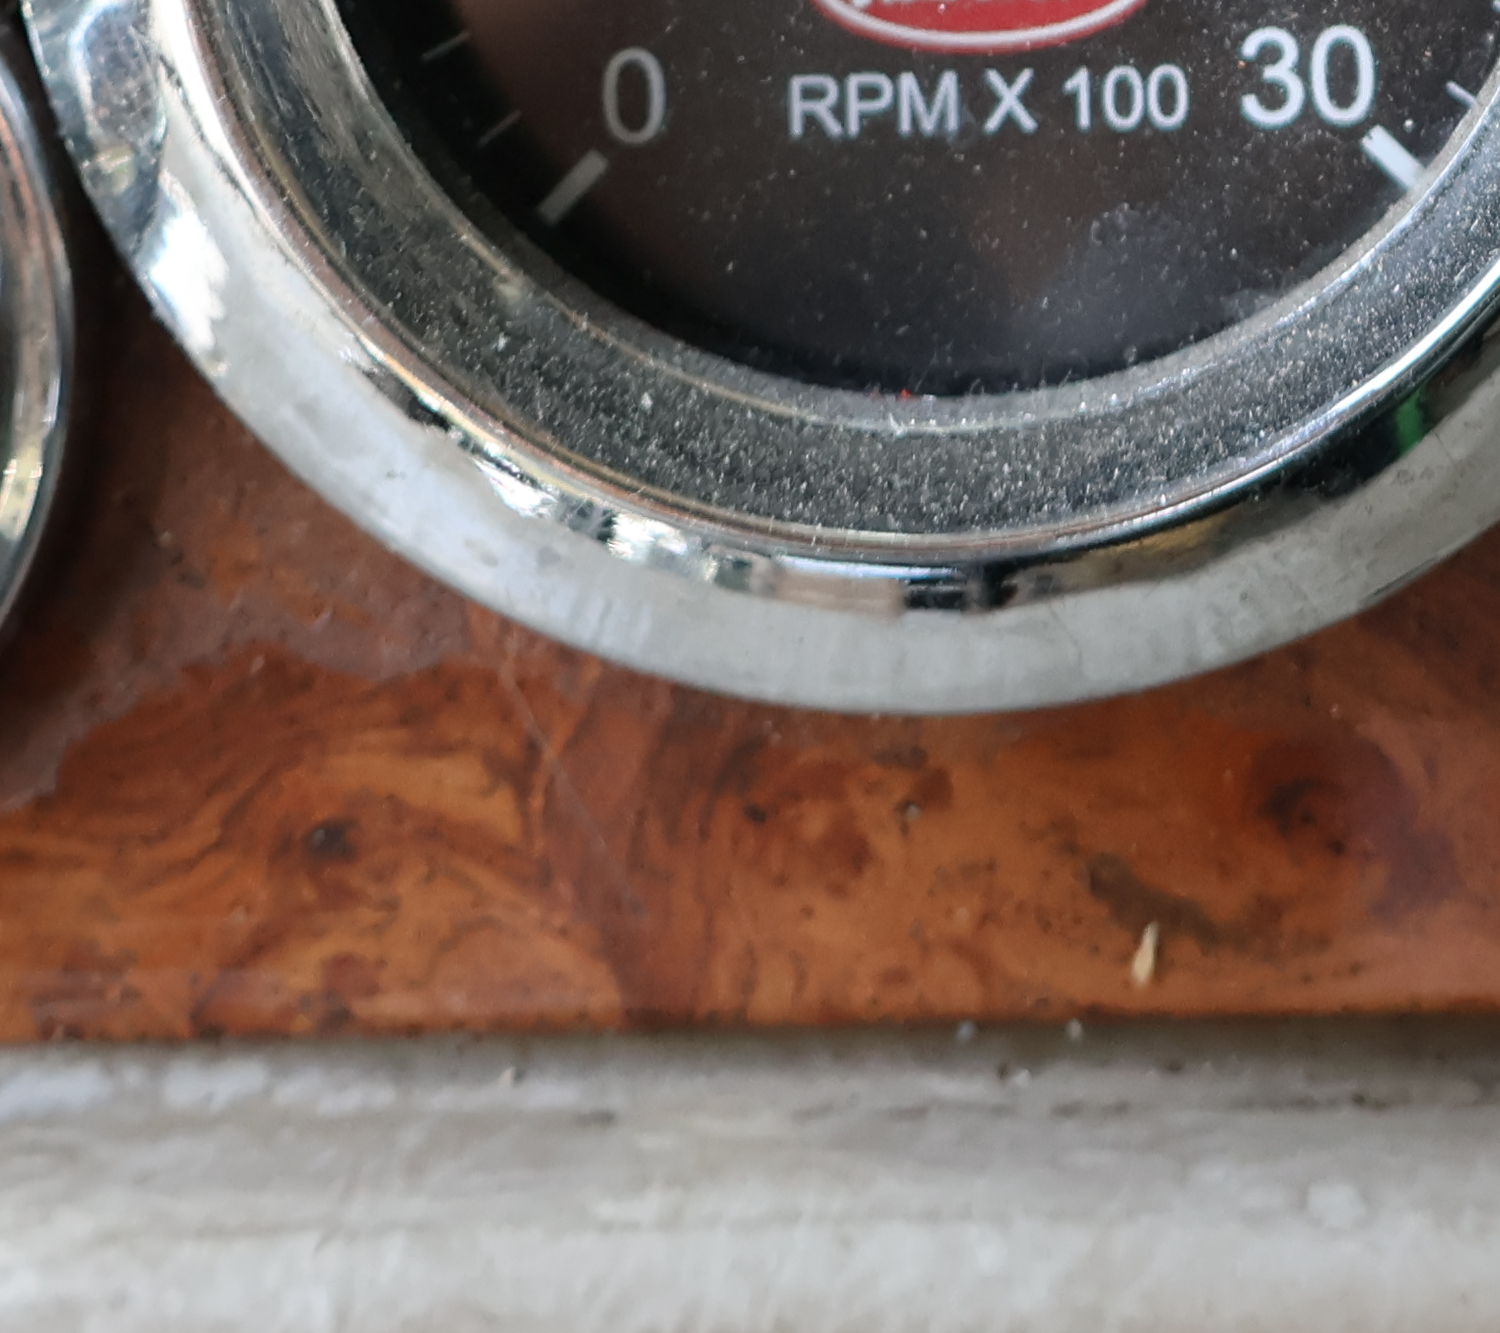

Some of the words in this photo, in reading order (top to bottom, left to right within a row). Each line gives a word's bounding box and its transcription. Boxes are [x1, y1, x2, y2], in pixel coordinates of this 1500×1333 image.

[602, 47, 668, 145] 0
[788, 71, 959, 138] RPM
[1063, 63, 1190, 130] 100
[1238, 23, 1375, 129] 30
